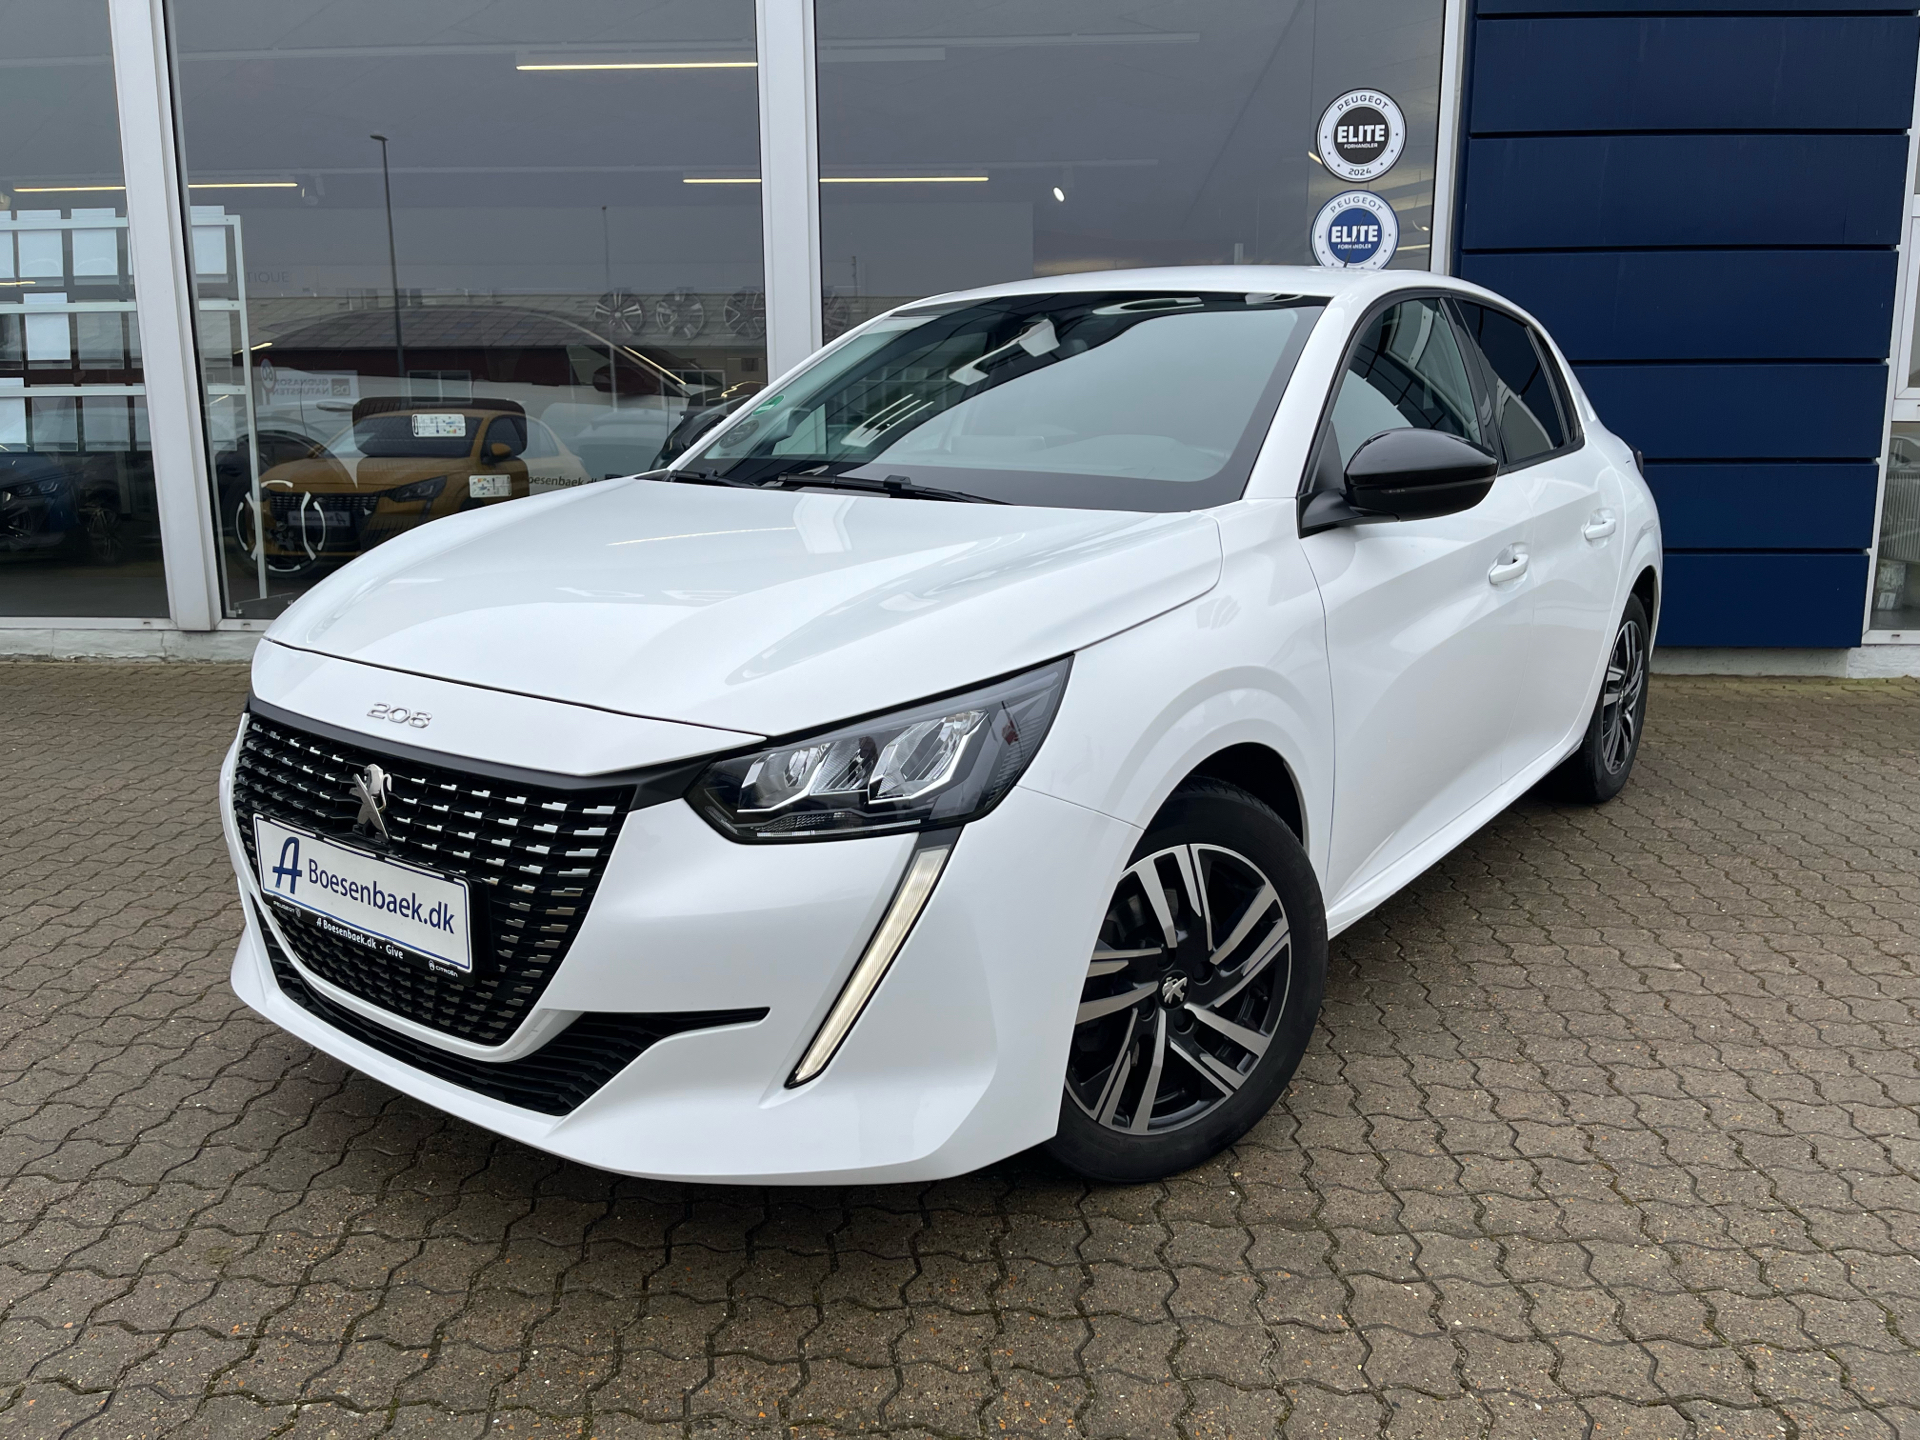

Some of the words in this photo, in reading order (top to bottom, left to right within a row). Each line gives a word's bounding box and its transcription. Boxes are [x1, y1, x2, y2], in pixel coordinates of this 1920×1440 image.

[1337, 95, 1389, 111] PEUGEOT
[1337, 124, 1385, 143] ELITE
[1348, 168, 1372, 176] 2024
[1330, 196, 1383, 213] PEUGEOT
[1331, 225, 1378, 243] ELITE
[366, 702, 432, 729] 208
[308, 858, 455, 935] Boesenbaek.dk
[323, 919, 377, 950] Boesenbaek.dk
[385, 944, 404, 959] Give
